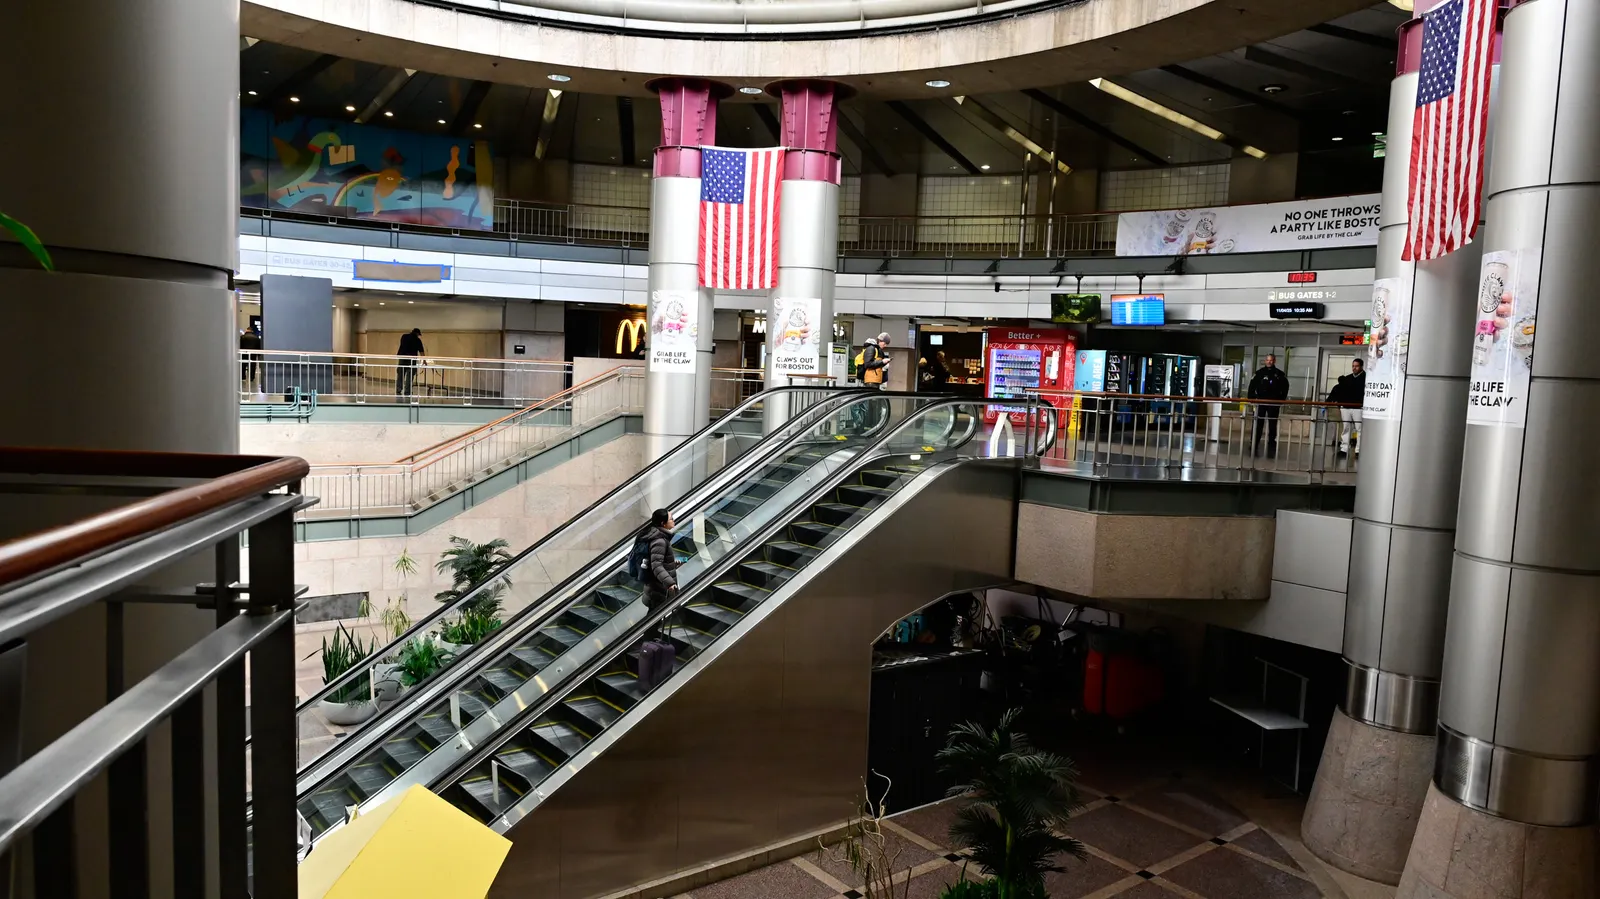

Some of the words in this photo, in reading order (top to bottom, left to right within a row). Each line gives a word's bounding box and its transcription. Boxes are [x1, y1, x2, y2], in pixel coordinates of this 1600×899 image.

[1284, 212, 1302, 222] NO
[1304, 209, 1328, 220] ONE
[1331, 204, 1381, 218] THROWS
[1270, 225, 1278, 234] A
[1280, 222, 1316, 233] PARTY
[1317, 220, 1342, 231] LIKE
[1344, 217, 1380, 229] BOSTO
[1278, 291, 1295, 300] BUS
[1482, 382, 1504, 393] LIFE
